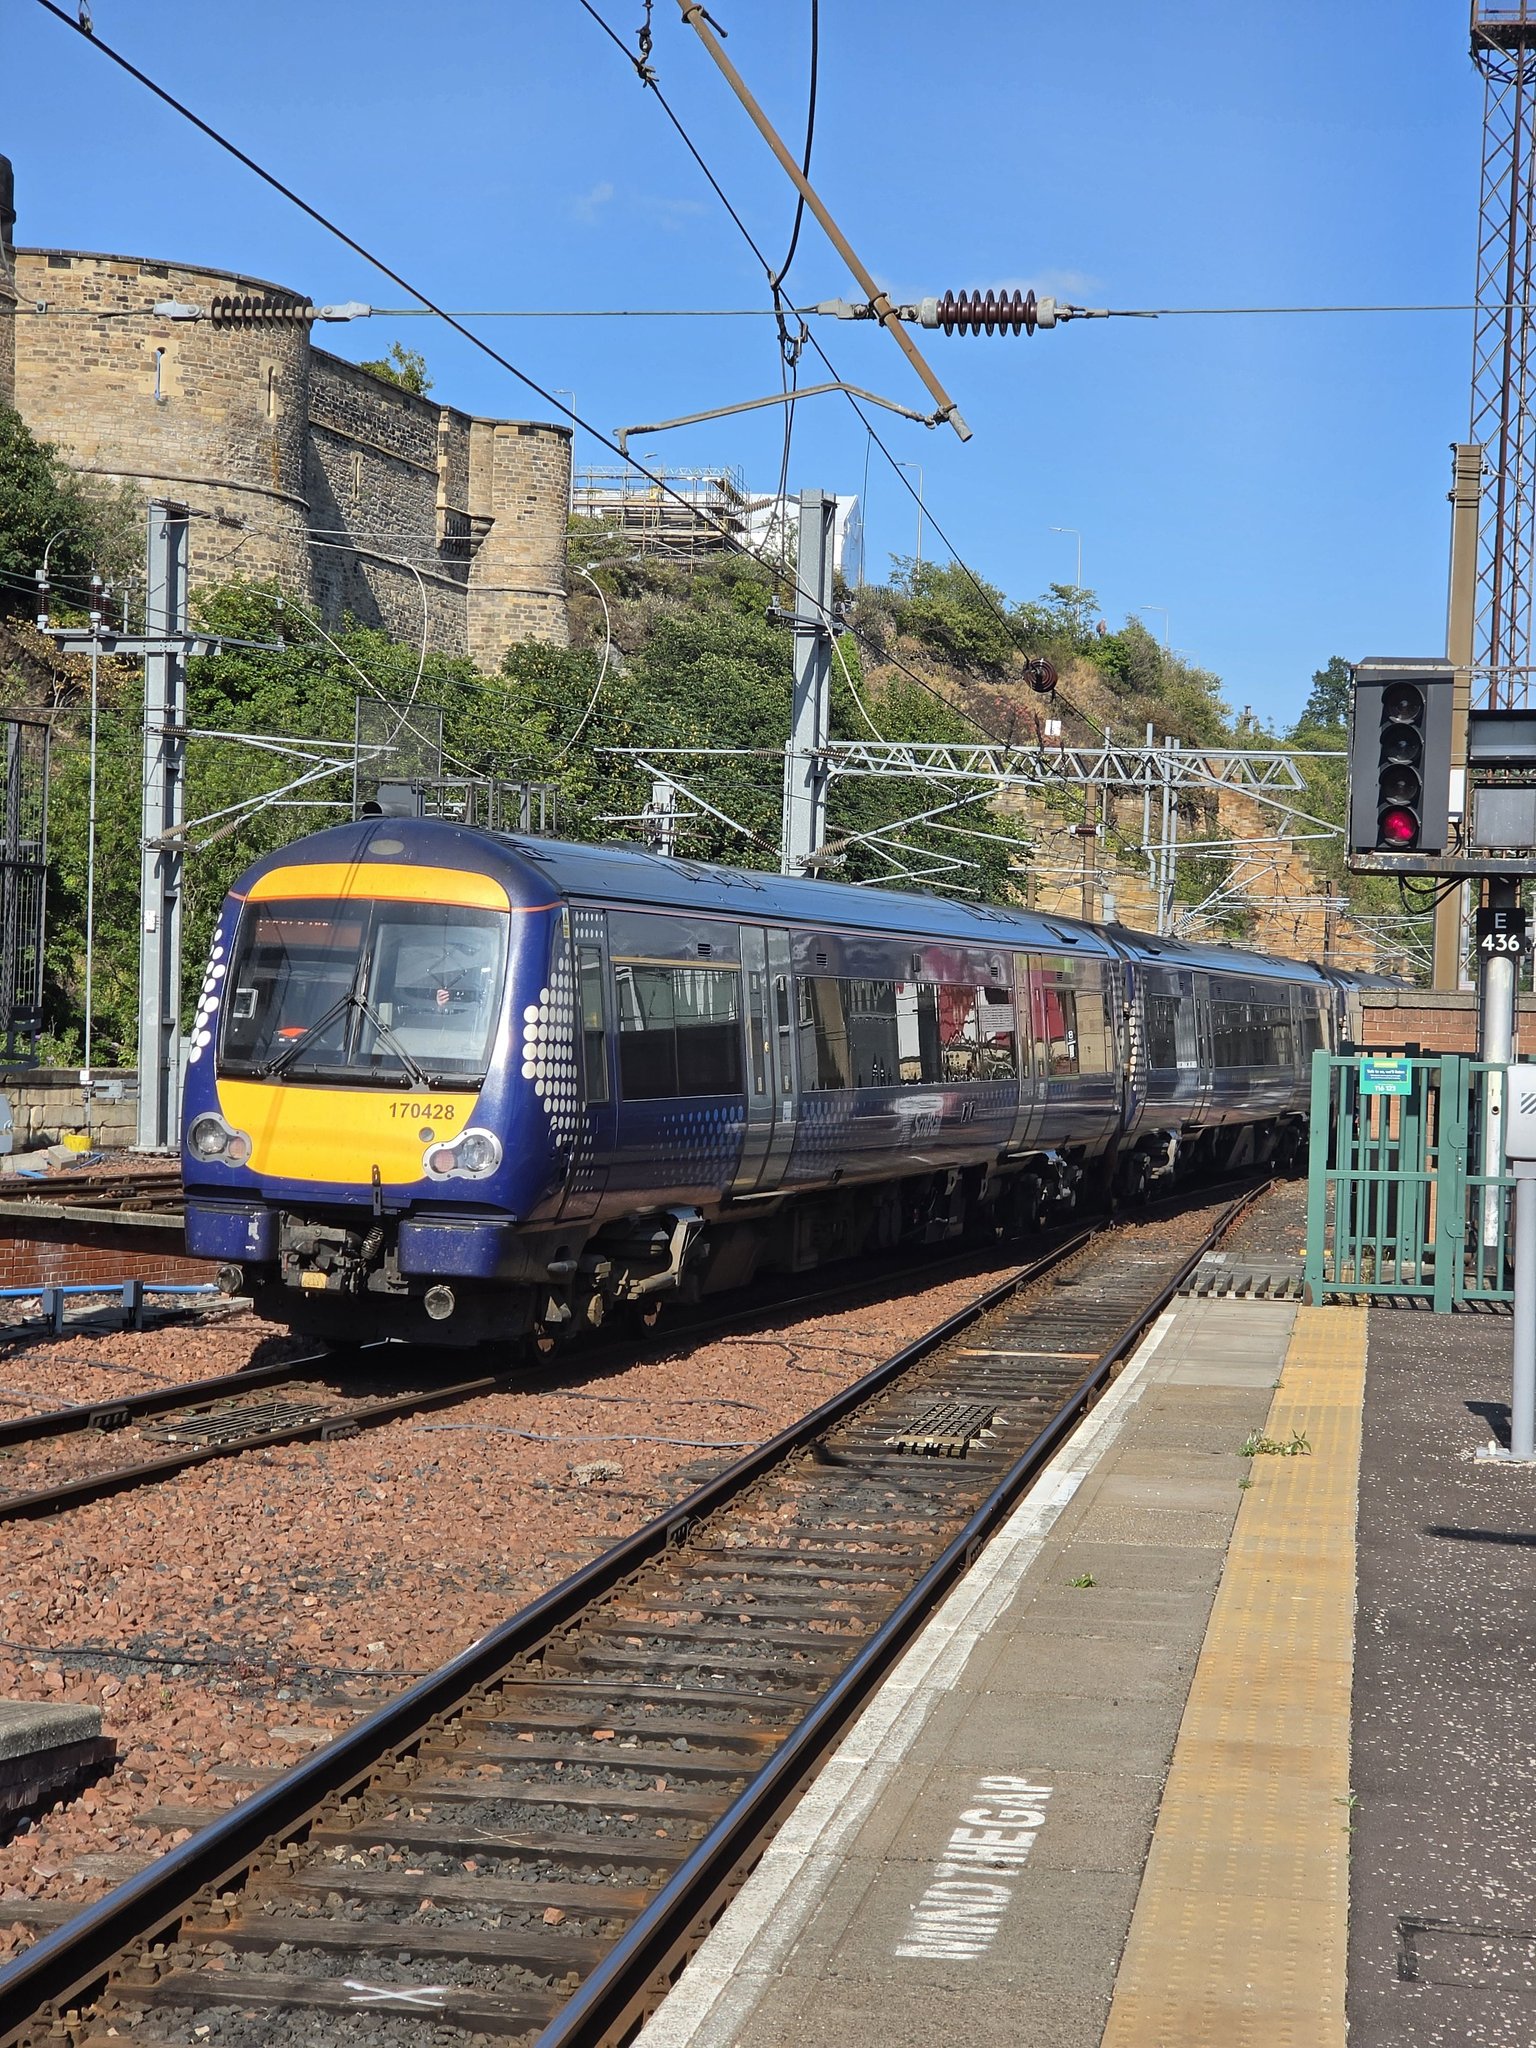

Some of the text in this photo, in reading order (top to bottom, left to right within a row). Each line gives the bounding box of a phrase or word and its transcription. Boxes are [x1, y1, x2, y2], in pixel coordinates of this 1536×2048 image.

[1494, 912, 1507, 929] E
[1481, 933, 1520, 952] 436
[389, 1102, 455, 1120] 170428
[895, 1774, 1054, 1960] MIND THE GAP
